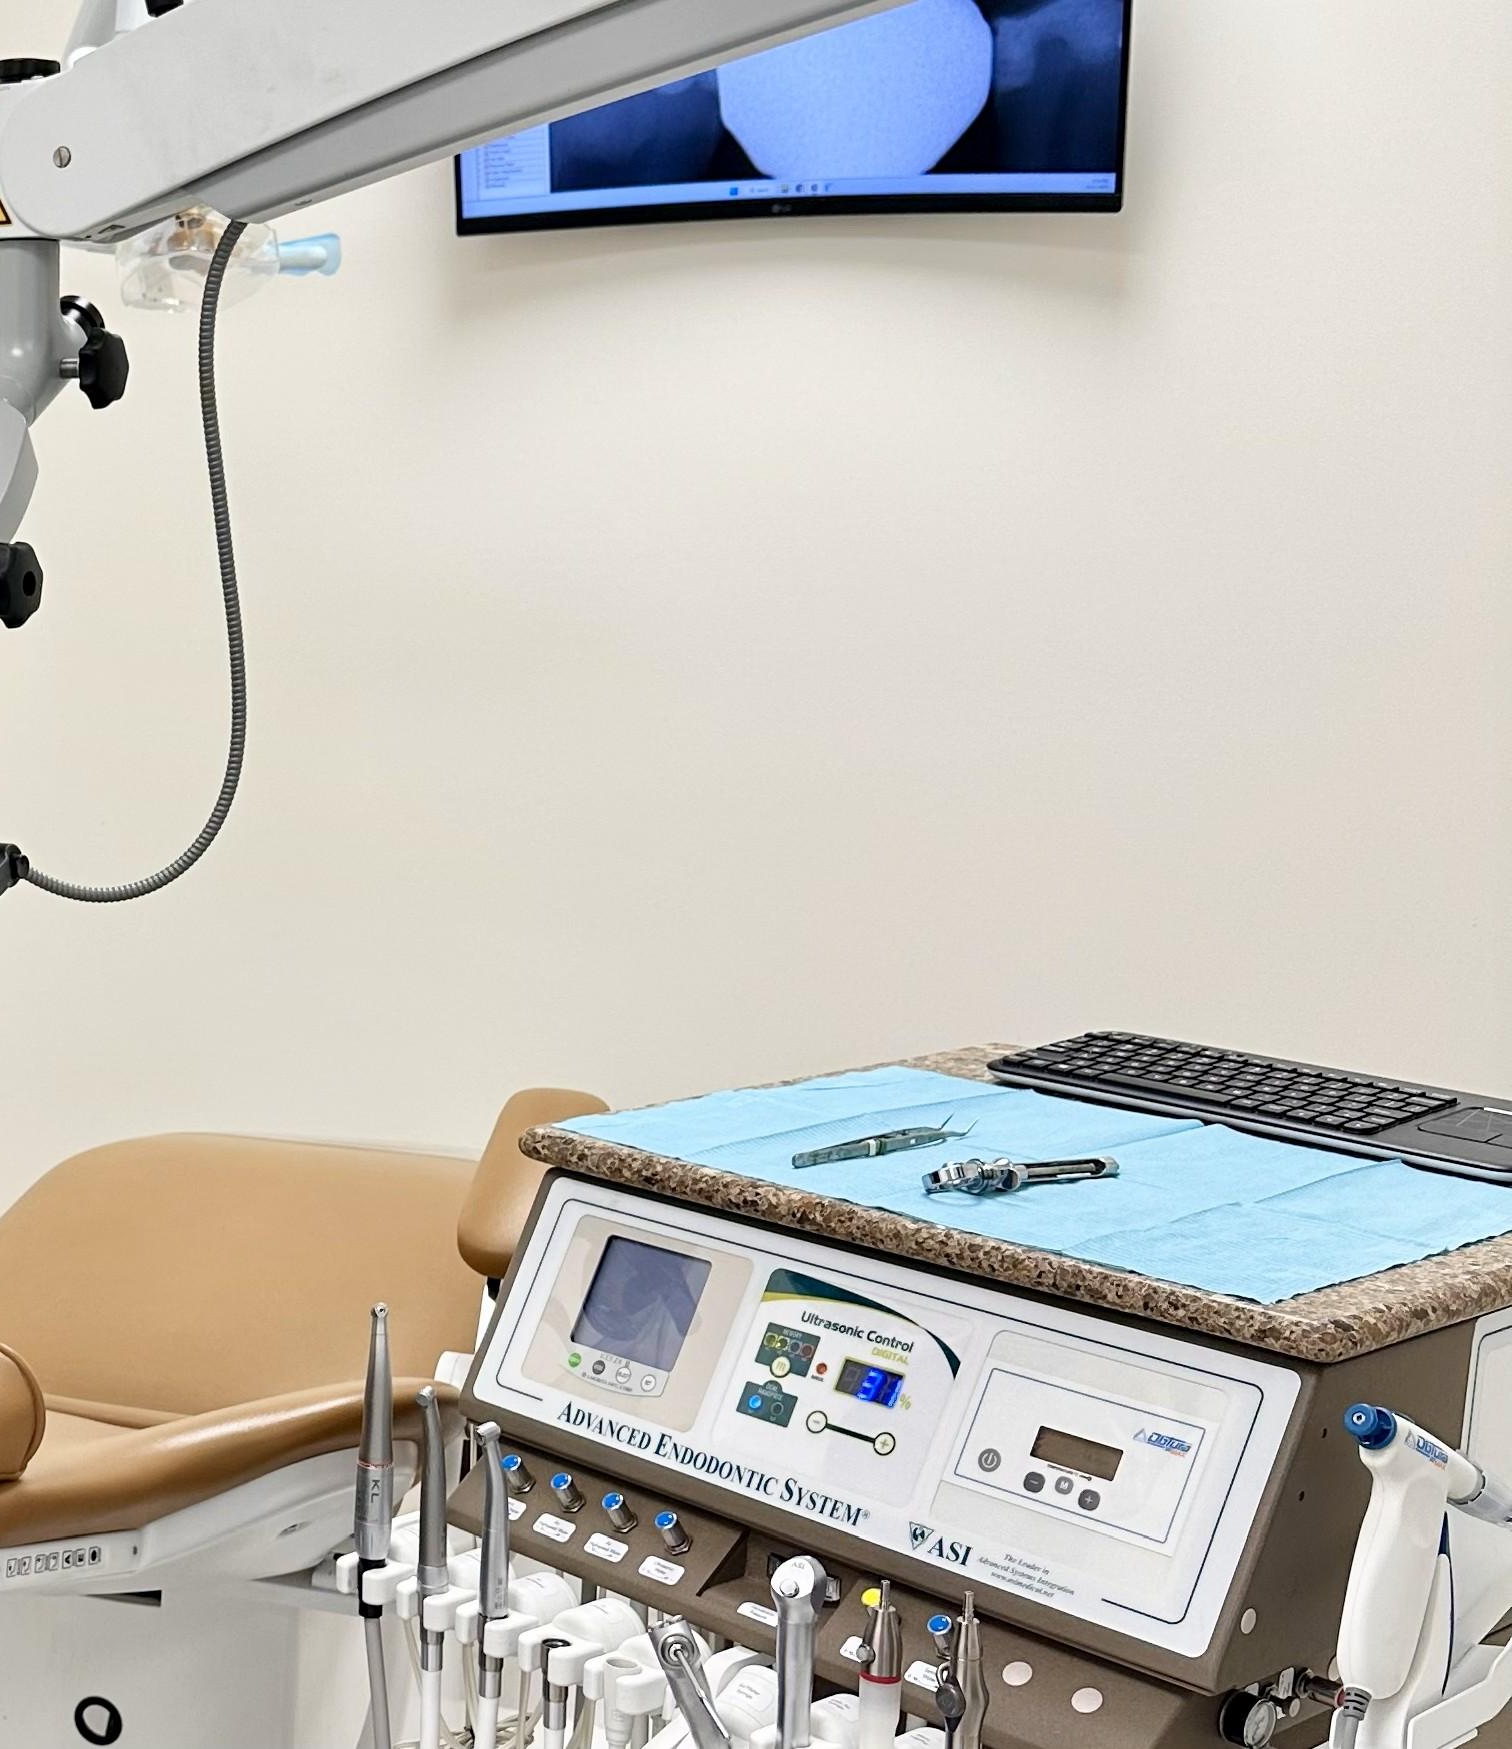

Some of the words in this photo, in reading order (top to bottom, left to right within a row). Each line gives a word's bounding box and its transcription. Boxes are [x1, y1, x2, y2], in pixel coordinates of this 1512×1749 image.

[801, 1310, 864, 1340] Ultrasonic
[866, 1330, 914, 1353] Control
[871, 1346, 909, 1365] DIGITAL
[557, 1401, 651, 1450] ADVANCED
[654, 1435, 779, 1496] ENDODONTIC
[927, 1535, 973, 1566] ASI
